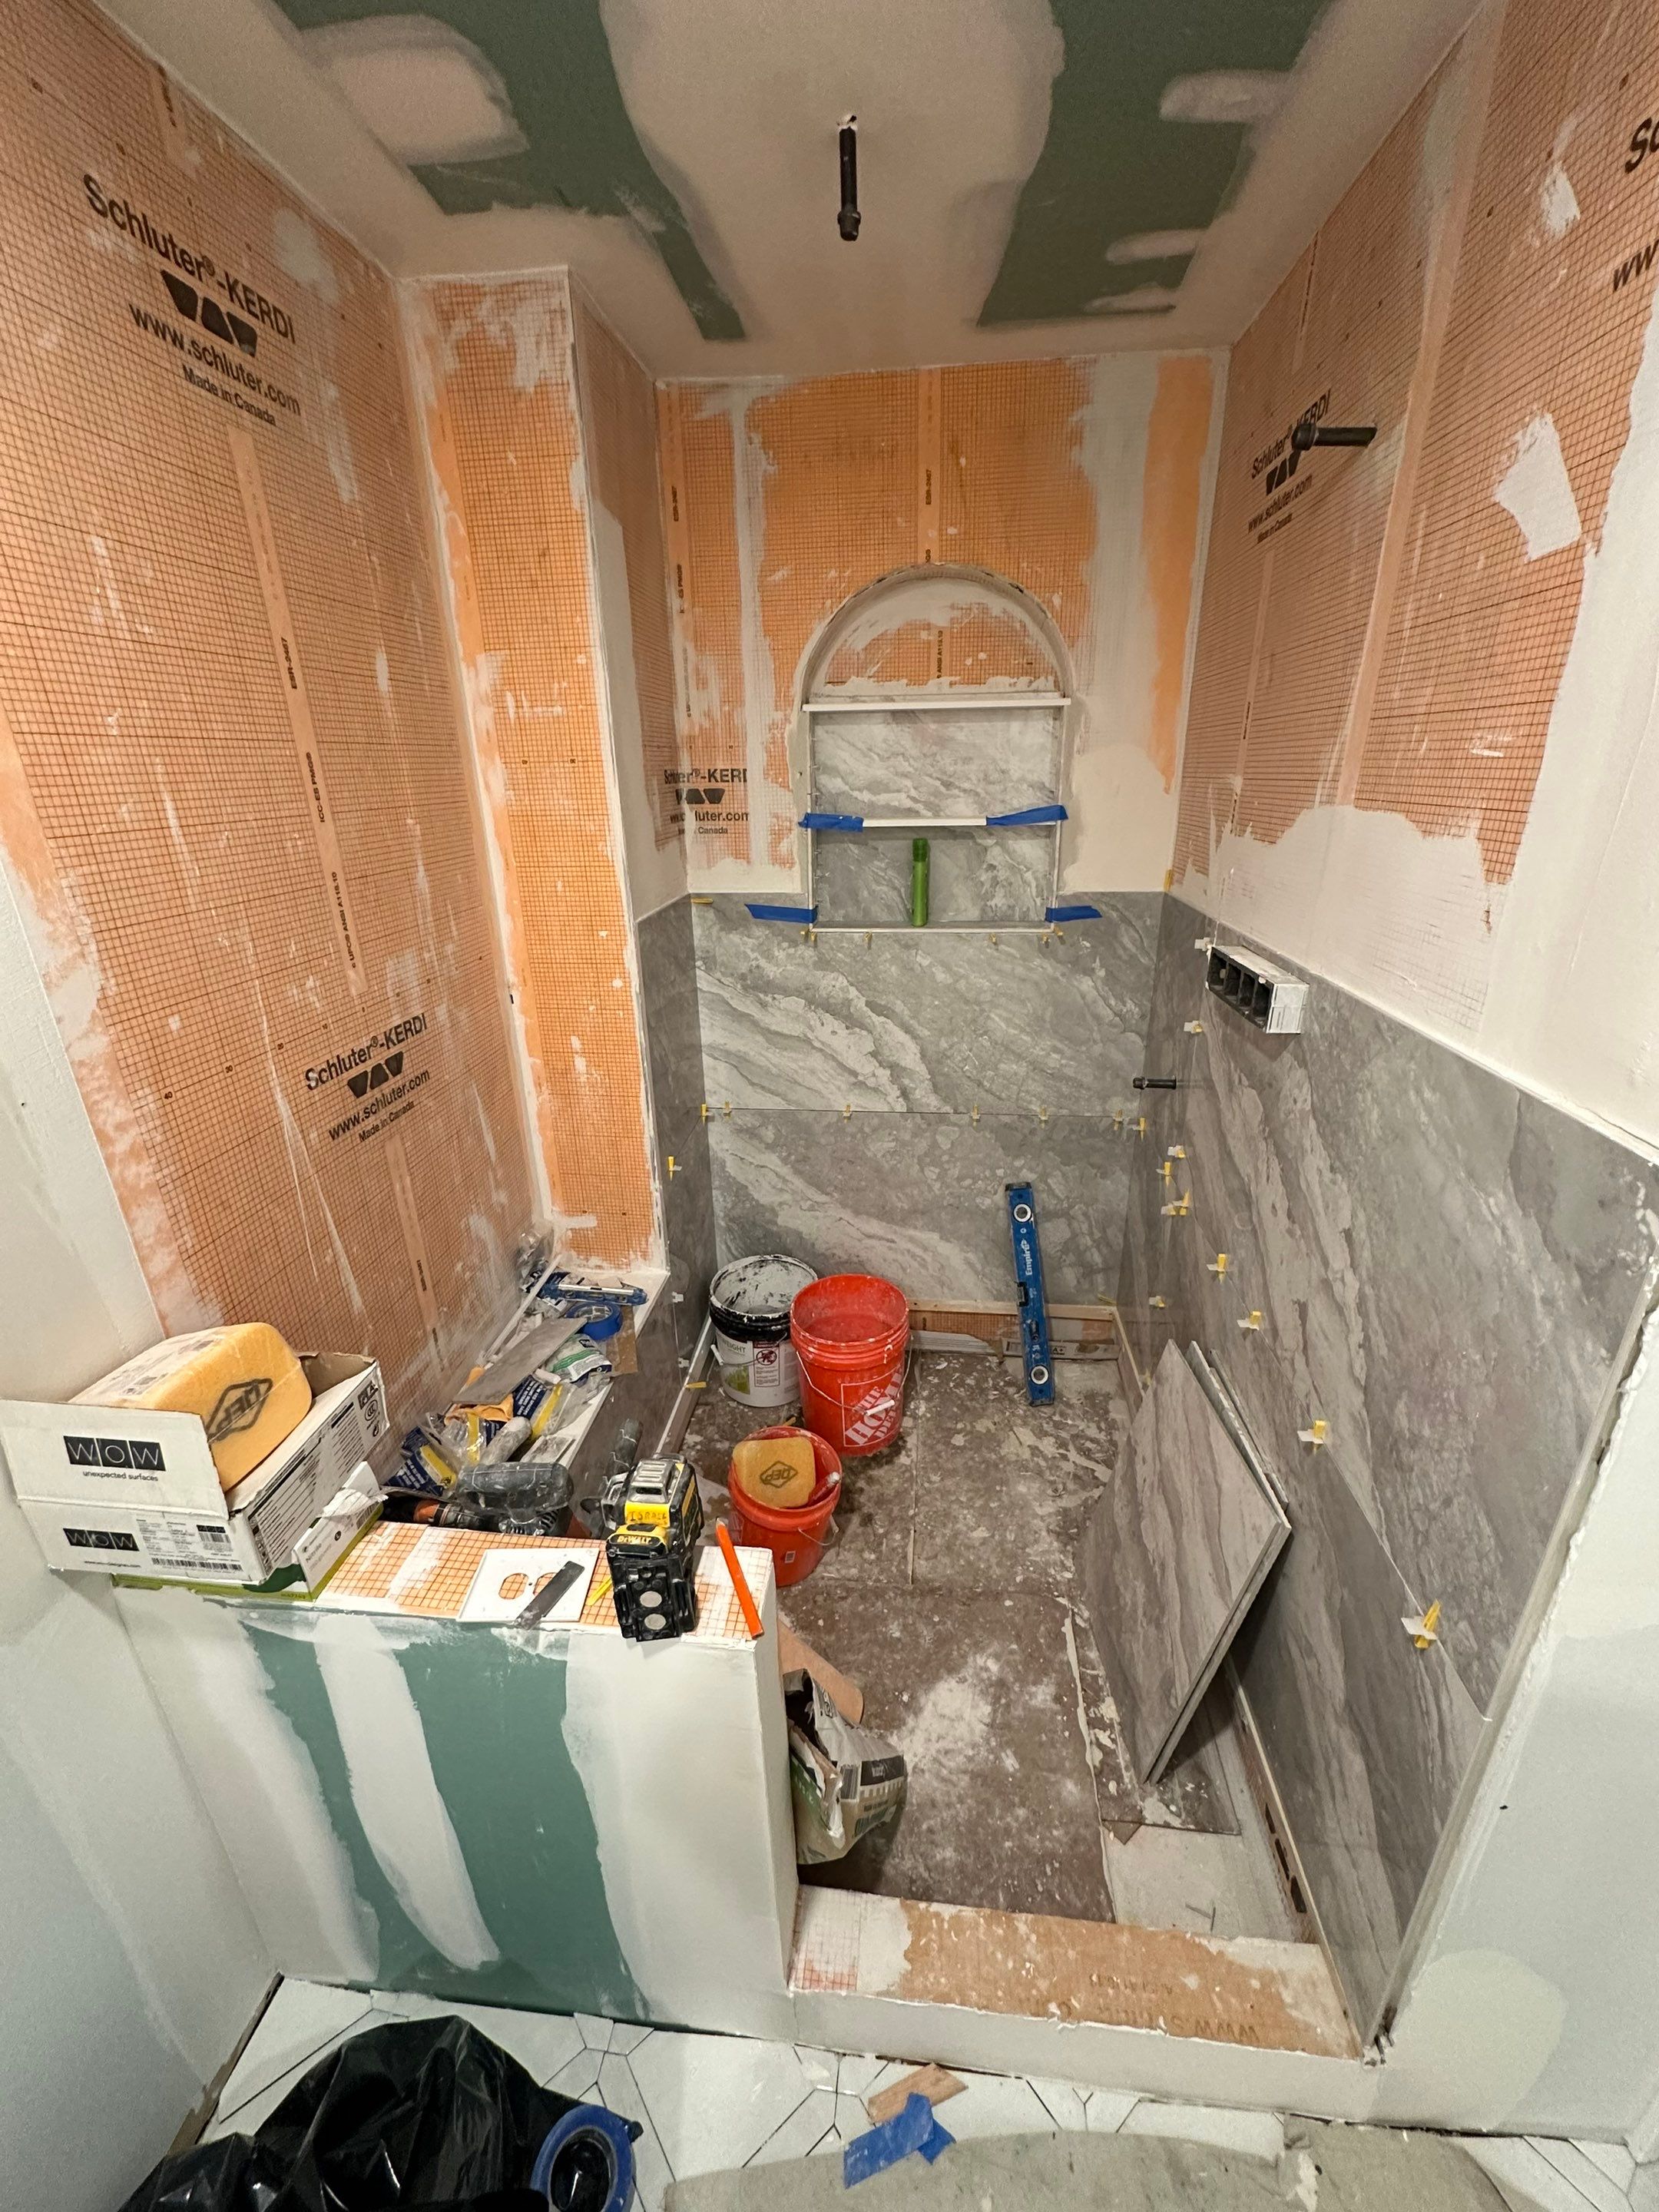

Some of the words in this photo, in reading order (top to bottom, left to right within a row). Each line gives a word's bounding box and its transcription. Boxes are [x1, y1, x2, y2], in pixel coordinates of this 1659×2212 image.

[129, 303, 301, 416] www.schluter.com
[182, 363, 219, 397] Made
[220, 389, 235, 403] in
[234, 392, 276, 426] Canada
[329, 1070, 430, 1141] www.schluter.com
[359, 1124, 380, 1142] Made
[1022, 1243, 1033, 1276] Empire
[67, 1441, 161, 1467] WOW
[82, 1470, 127, 1479] unexpected
[127, 1473, 159, 1482] surfaces
[67, 1531, 134, 1549] WOW
